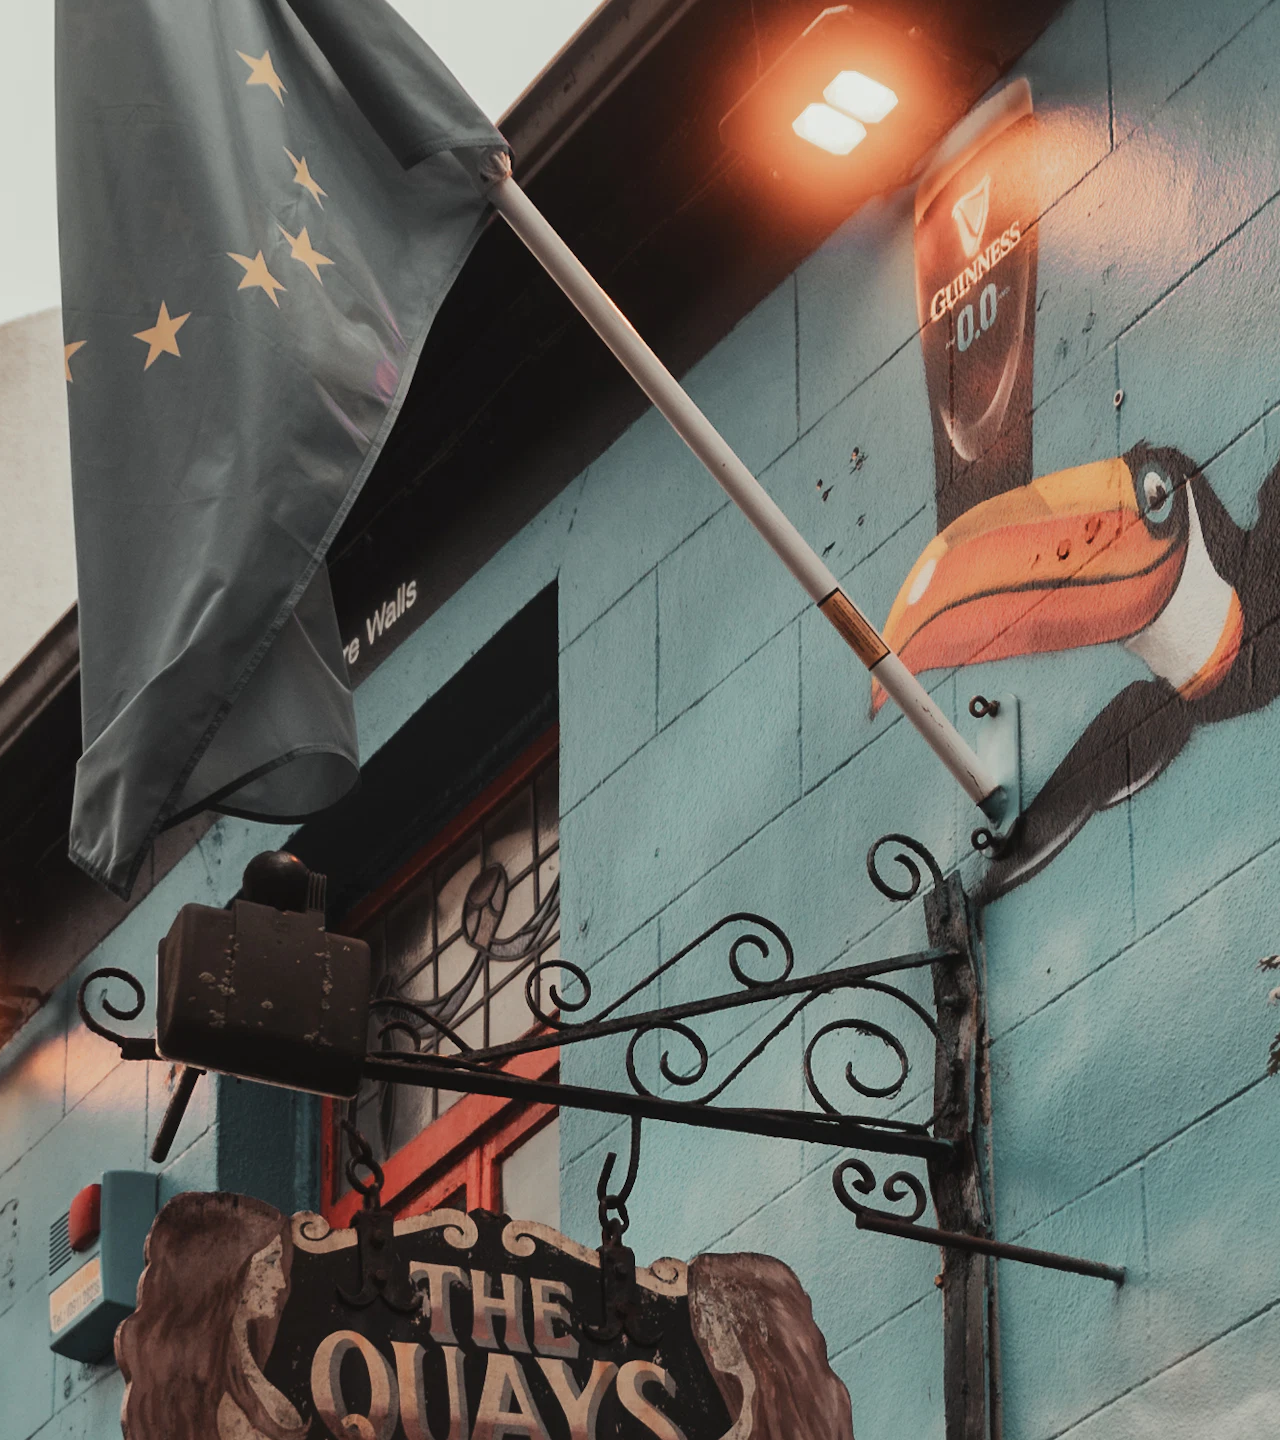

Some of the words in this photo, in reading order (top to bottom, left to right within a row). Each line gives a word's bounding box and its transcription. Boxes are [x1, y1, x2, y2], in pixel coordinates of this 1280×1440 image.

[930, 221, 1022, 322] GUINNESS
[957, 282, 997, 353] 0.0
[365, 579, 418, 645] Walls
[409, 1261, 579, 1359] THE
